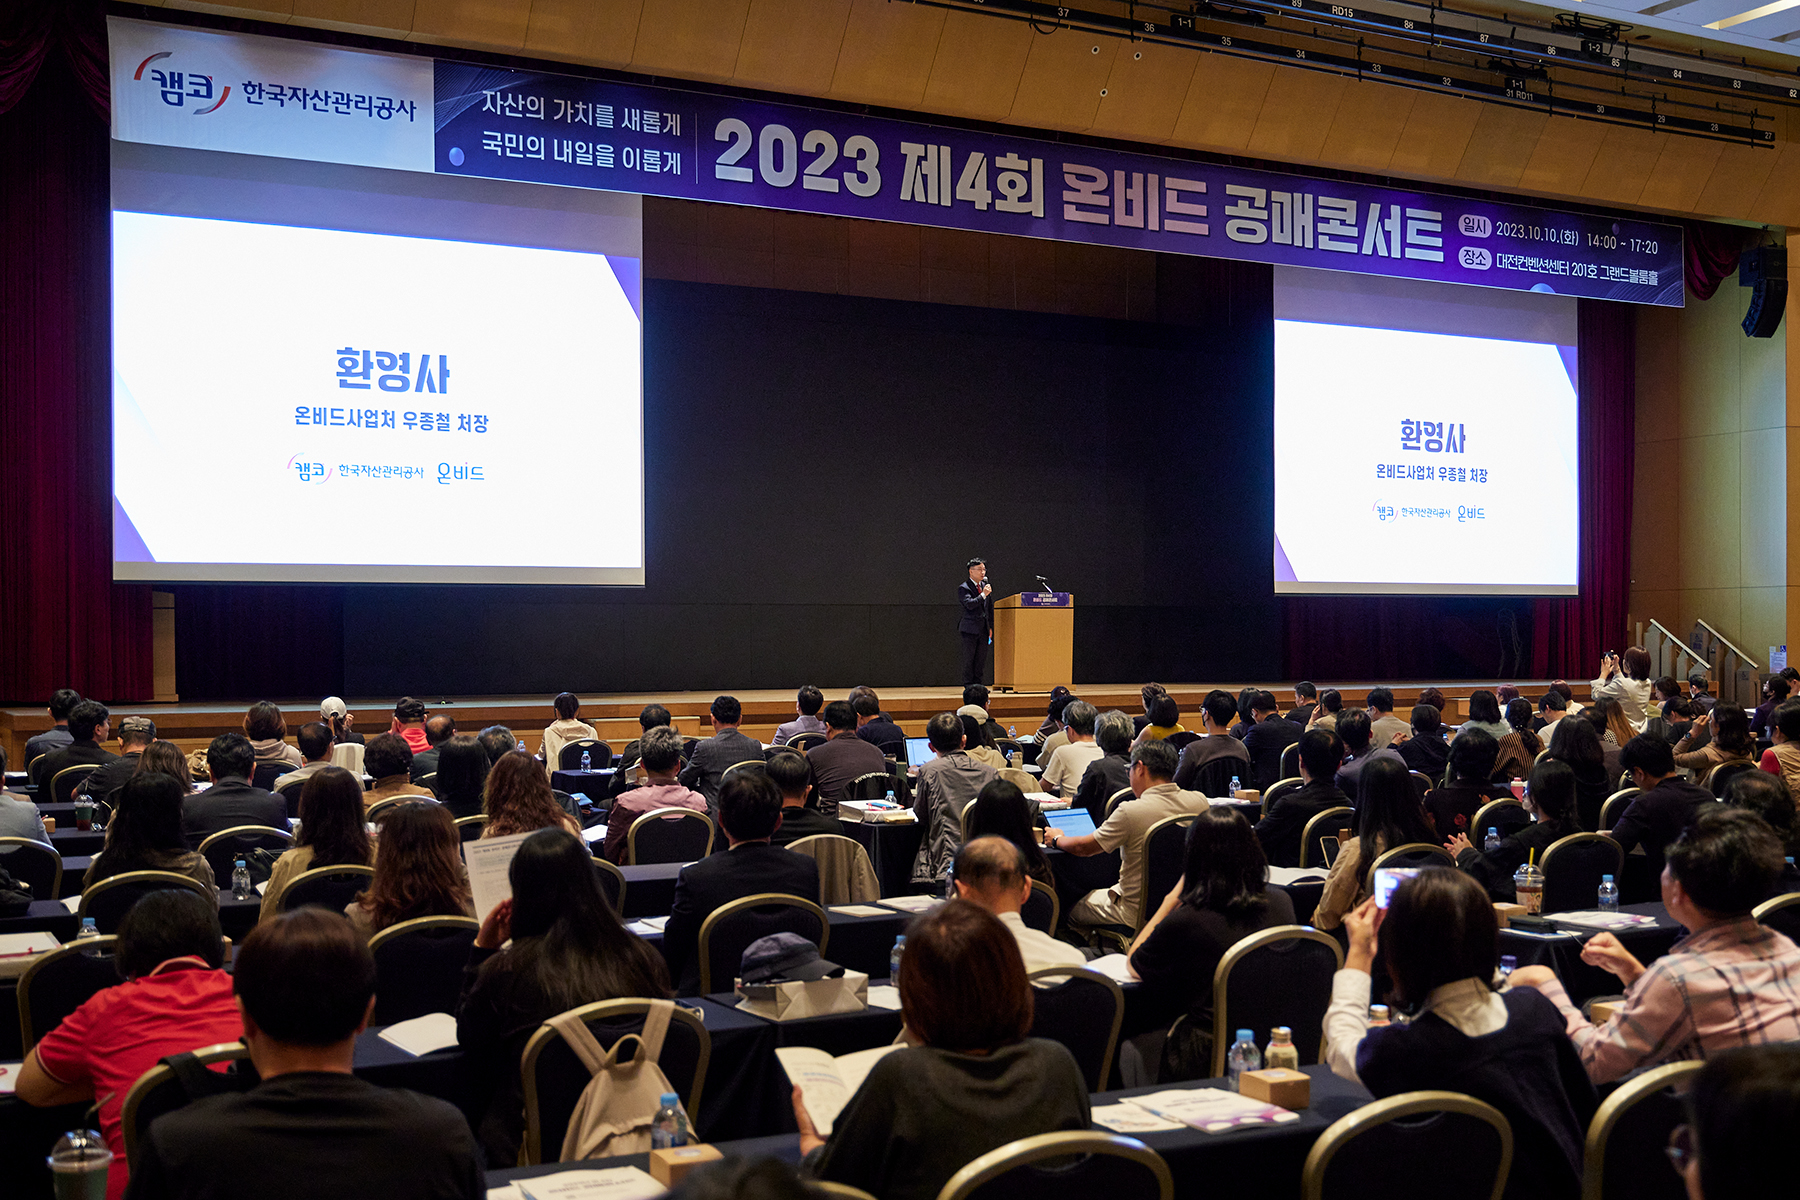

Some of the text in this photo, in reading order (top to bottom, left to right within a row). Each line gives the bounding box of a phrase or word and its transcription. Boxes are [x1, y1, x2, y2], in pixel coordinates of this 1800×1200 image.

[1057, 7, 1070, 18] 37
[1332, 6, 1354, 18] RD15
[1144, 22, 1155, 33] 36
[1178, 17, 1192, 28] 1-1
[1404, 20, 1414, 30] 88
[1221, 36, 1232, 46] 35
[1479, 33, 1490, 43] 87
[1296, 49, 1306, 59] 34
[1547, 46, 1557, 55] 86
[1372, 63, 1382, 73] 33
[1611, 58, 1621, 67] 85
[1673, 69, 1683, 79] 84
[1442, 77, 1452, 86] 32
[1511, 80, 1523, 89] 1-1
[1732, 80, 1742, 89] 83
[151, 69, 417, 122] 캠코 한국자산관리공사
[1506, 88, 1534, 101] 31 RD11
[1789, 89, 1798, 98] 82
[482, 90, 681, 136] 자산의 가치를 새롭게
[1596, 105, 1605, 114] 30
[1657, 115, 1666, 124] 29
[1711, 123, 1719, 132] 28
[1764, 131, 1773, 140] 27
[482, 131, 681, 175] 국민의 내일을 이롭게
[714, 117, 1444, 263] 2023 제4회 온비드 공매콘서트
[1463, 216, 1487, 235] 일시
[1496, 221, 1579, 246] 2023.10.10.(화)
[1587, 233, 1617, 250] 14:00
[1630, 238, 1658, 255] 17:20
[1463, 249, 1659, 286] 장소 대전컨벤션센터 201호 그랜드볼룸홀
[336, 346, 450, 394] 환영사
[294, 405, 489, 434] 온비드사업처 우종철 처장
[1401, 418, 1466, 453] 환영사
[295, 462, 485, 485] 캠코 한국자산관리공사 온비드
[1376, 463, 1488, 483] 온비드사업처 우종철 처장
[1377, 504, 1485, 523] 캠코 한국자산관리공사 온비드
